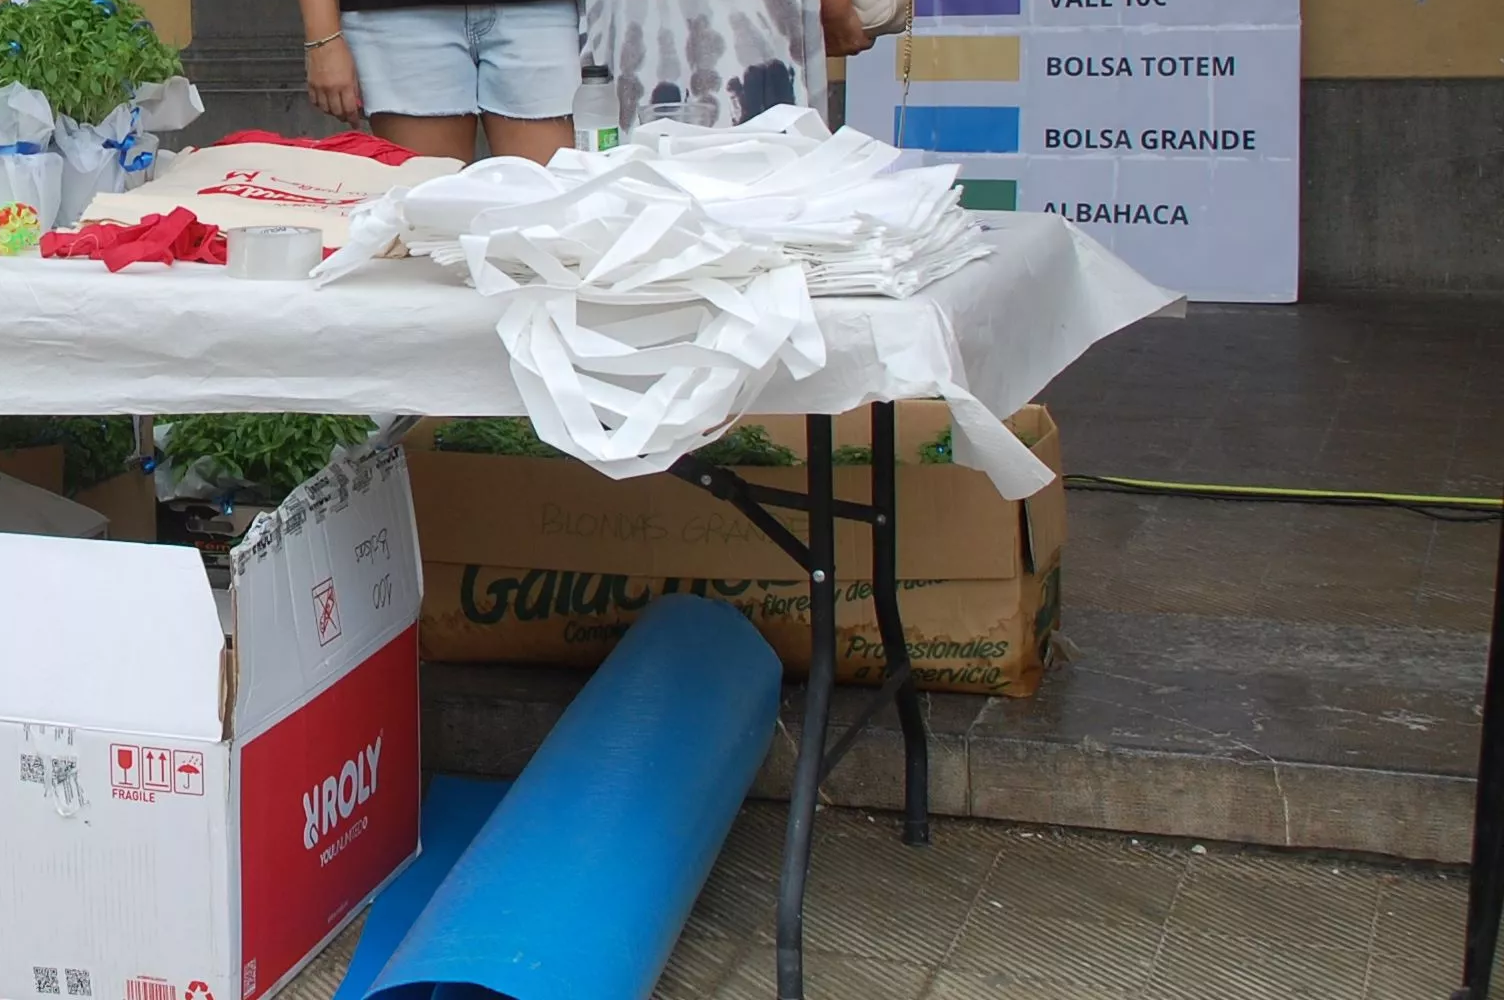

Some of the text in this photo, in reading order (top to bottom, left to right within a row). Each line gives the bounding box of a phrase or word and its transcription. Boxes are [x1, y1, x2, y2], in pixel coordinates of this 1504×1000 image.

[1046, 56, 1235, 77] BOLSA TOTEM
[1044, 128, 1256, 151] BOLSA GRANDE
[762, 592, 813, 618] flore
[844, 634, 1009, 660] Proesionales
[911, 663, 1002, 686] servicio
[112, 787, 156, 803] FRAGILE
[322, 736, 382, 835] ROLY
